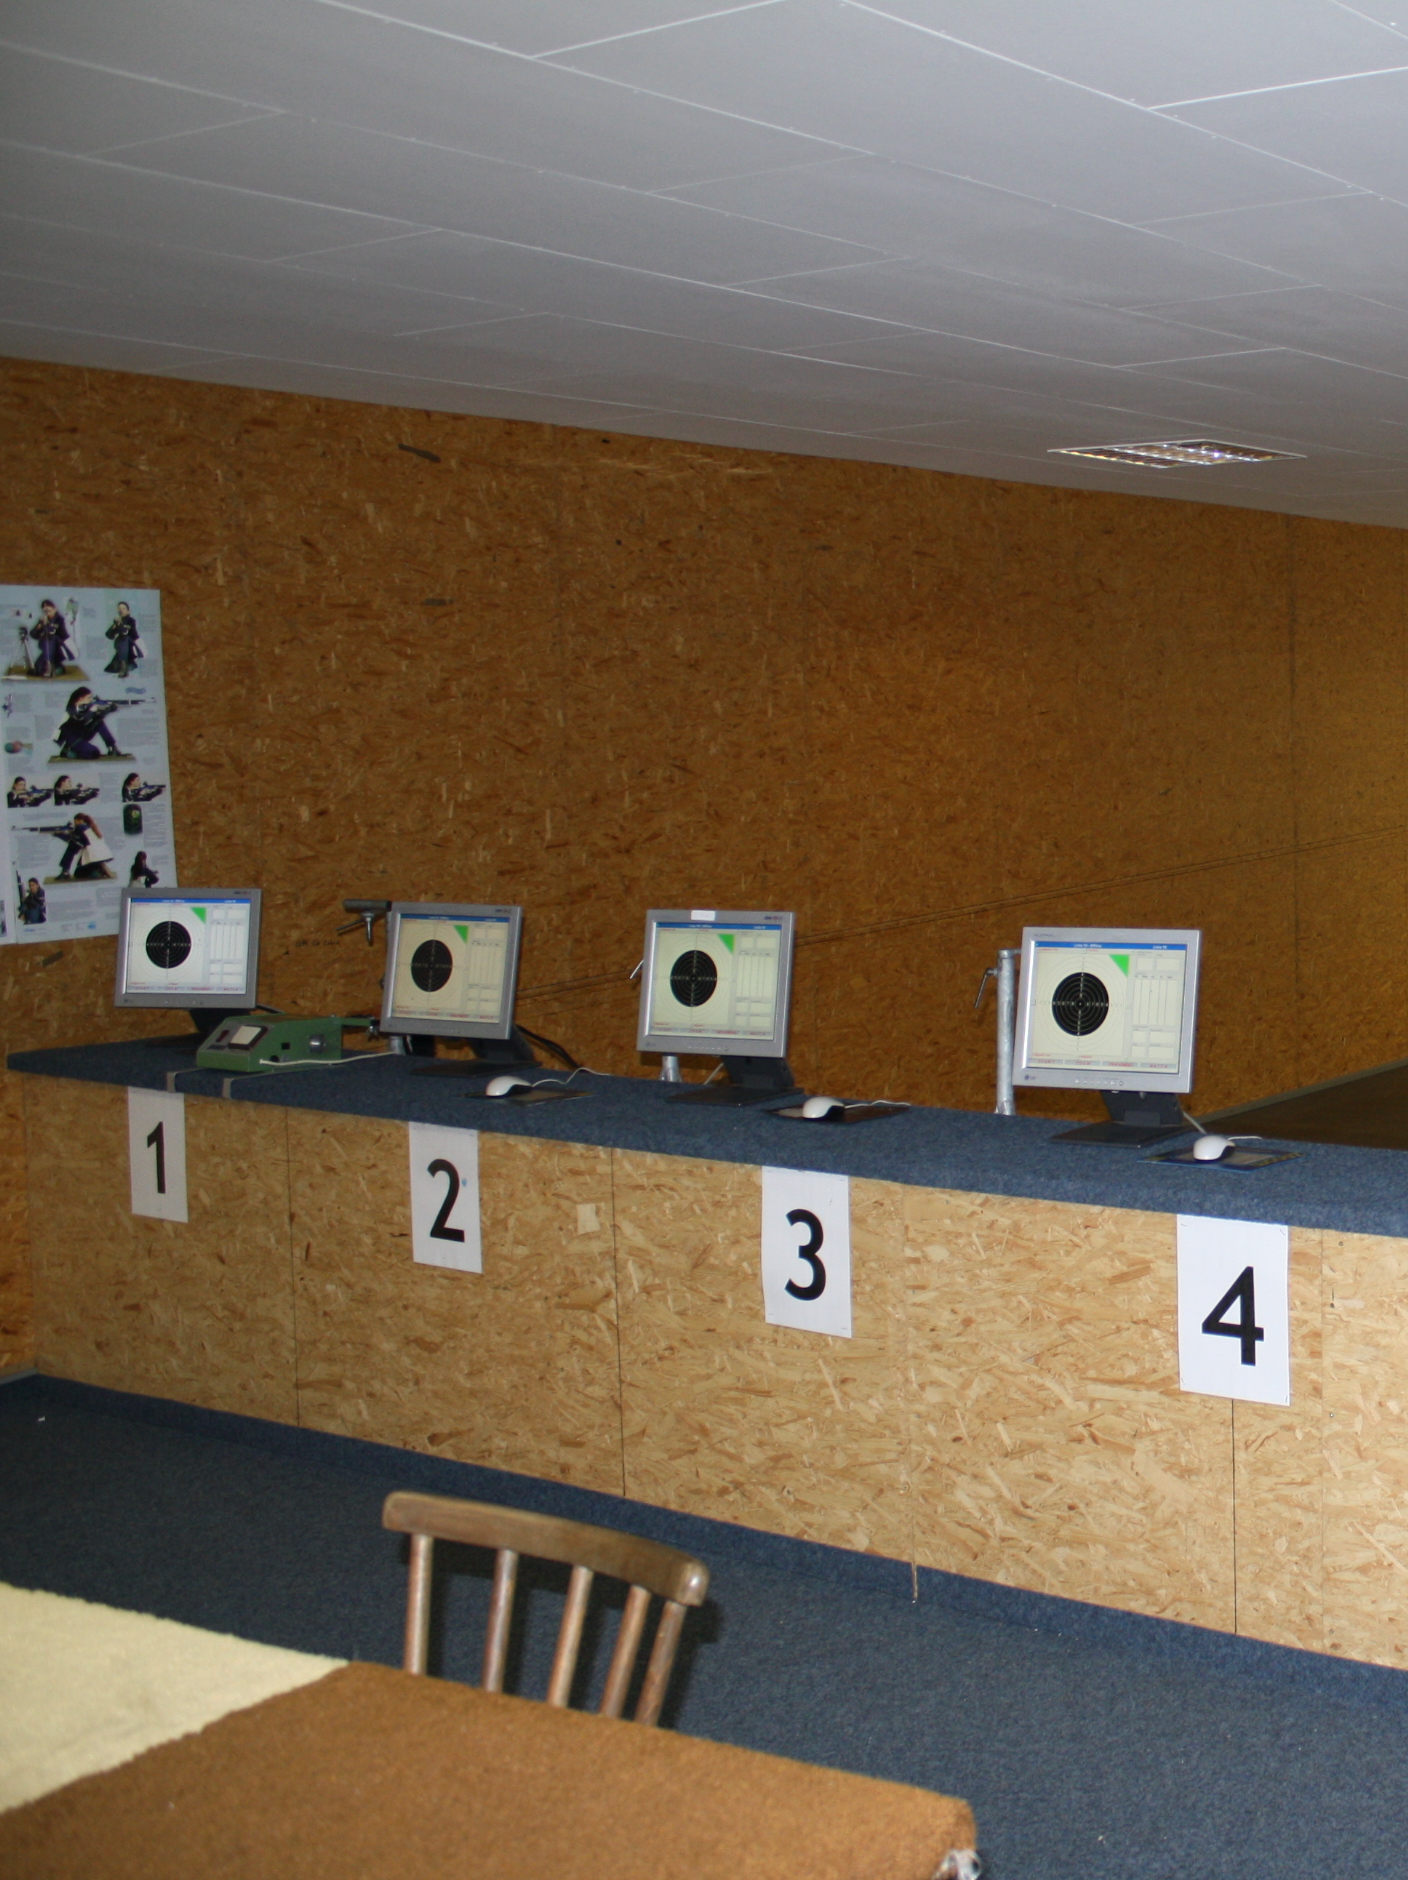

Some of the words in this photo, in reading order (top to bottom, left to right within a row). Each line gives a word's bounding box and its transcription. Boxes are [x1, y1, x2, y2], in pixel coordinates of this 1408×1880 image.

[147, 1121, 166, 1194] 1
[427, 1159, 465, 1243] 2
[785, 1209, 826, 1301] 3
[1202, 1266, 1264, 1366] 4
